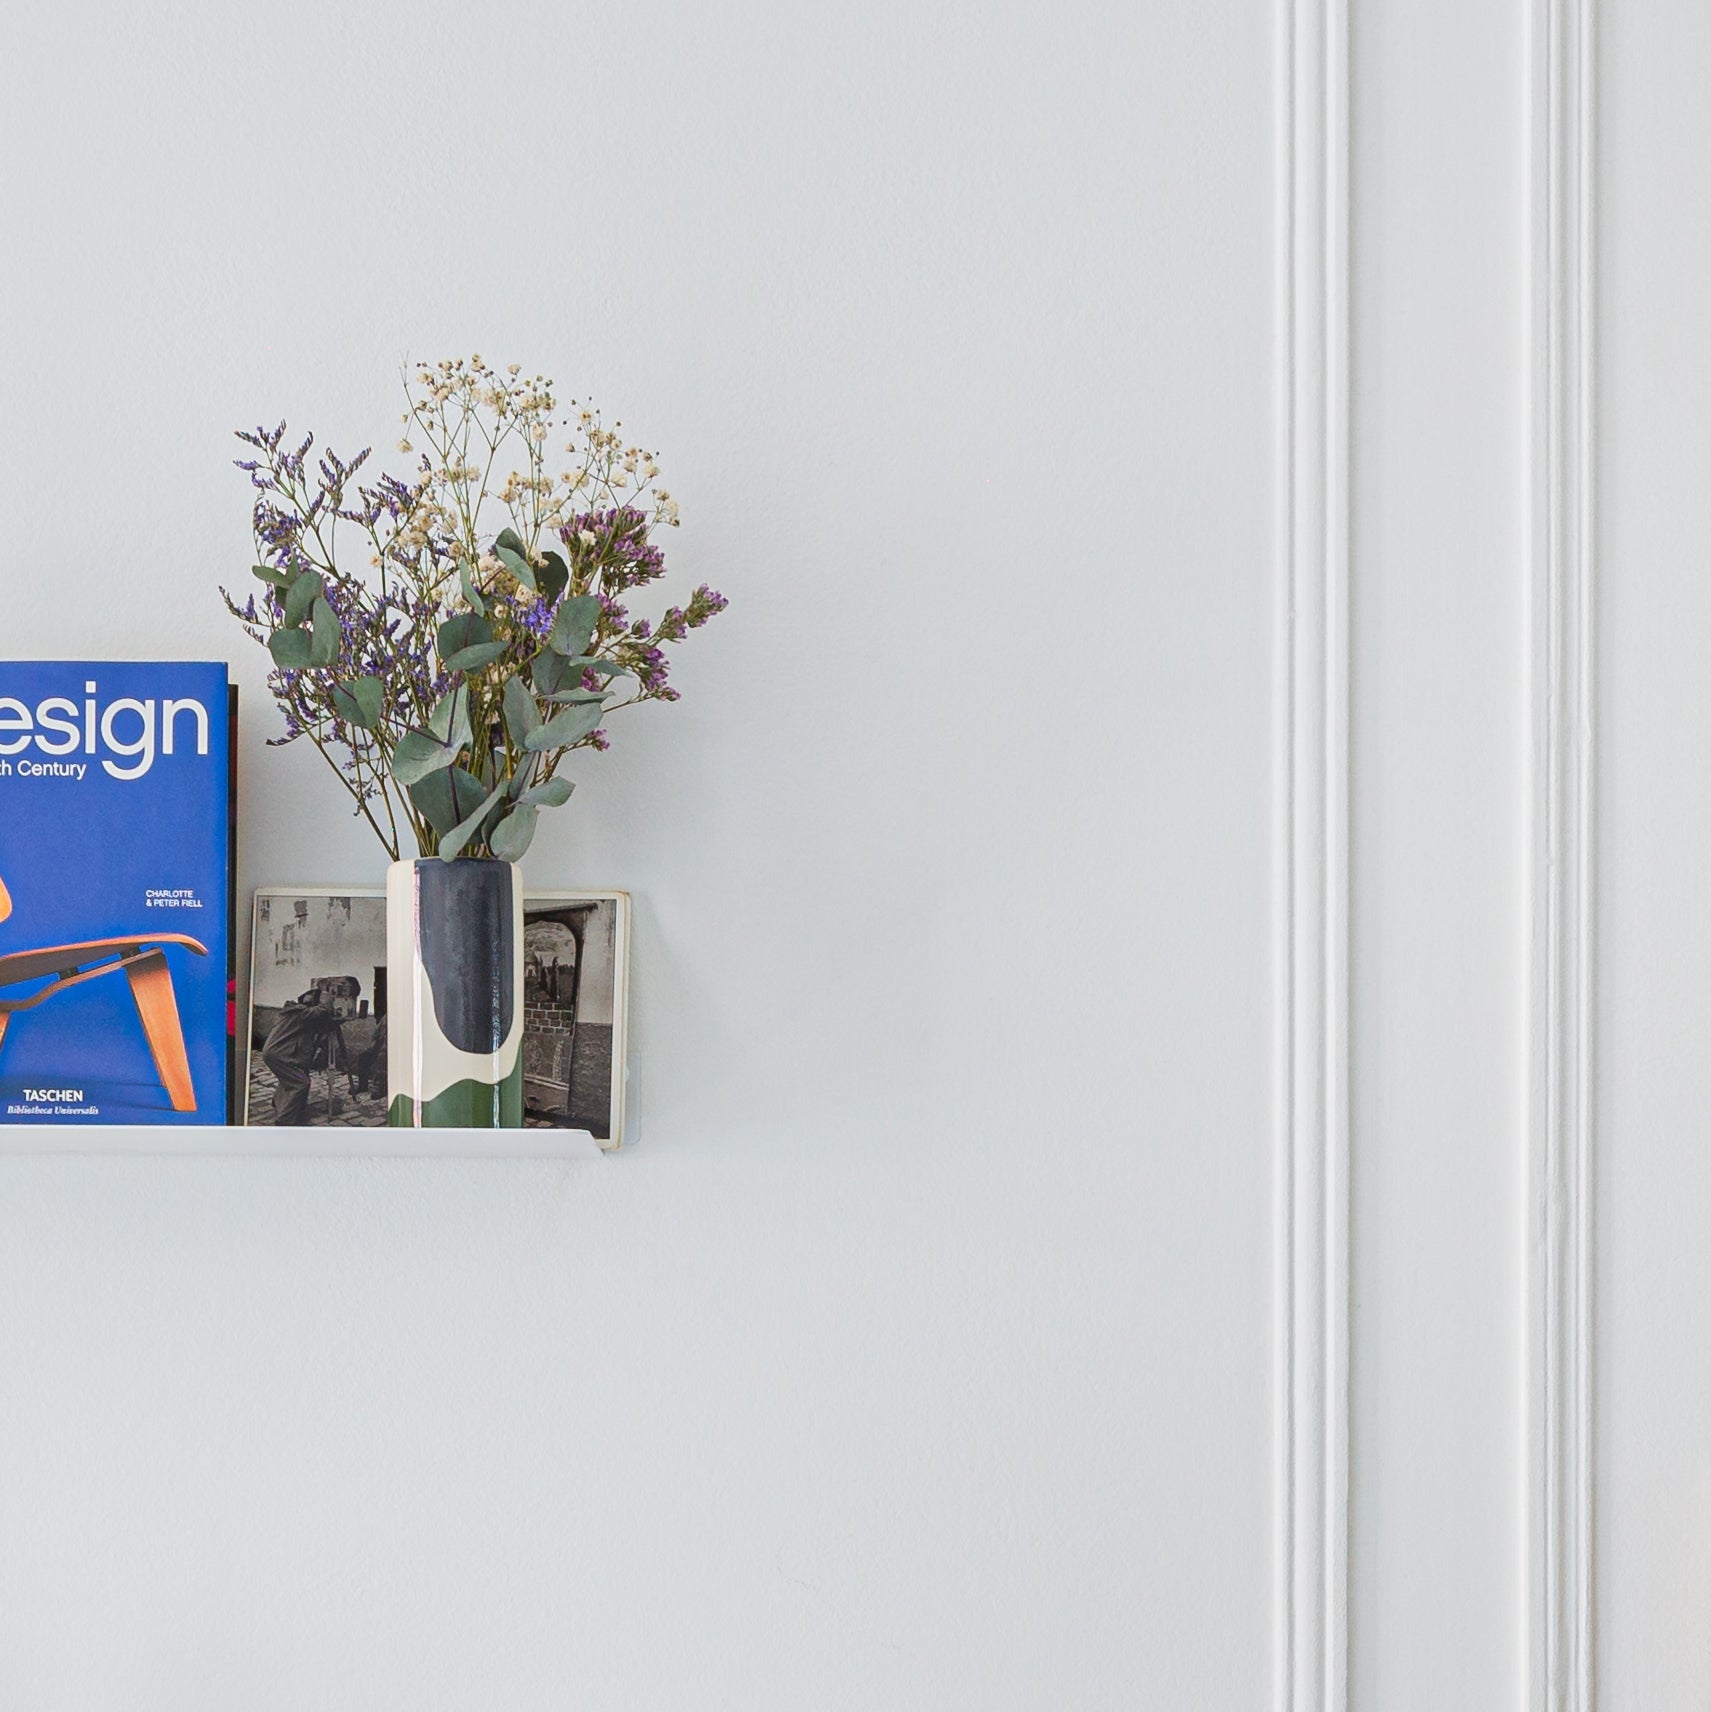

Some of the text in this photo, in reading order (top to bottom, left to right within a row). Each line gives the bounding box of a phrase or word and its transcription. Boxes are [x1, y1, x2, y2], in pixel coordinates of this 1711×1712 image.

[17, 760, 86, 780] Century
[145, 889, 193, 898] CHARLOTTE
[145, 899, 152, 907] &
[154, 899, 179, 907] PETER
[23, 1089, 83, 1102] TASCHEN
[54, 1105, 99, 1115] Universalis
